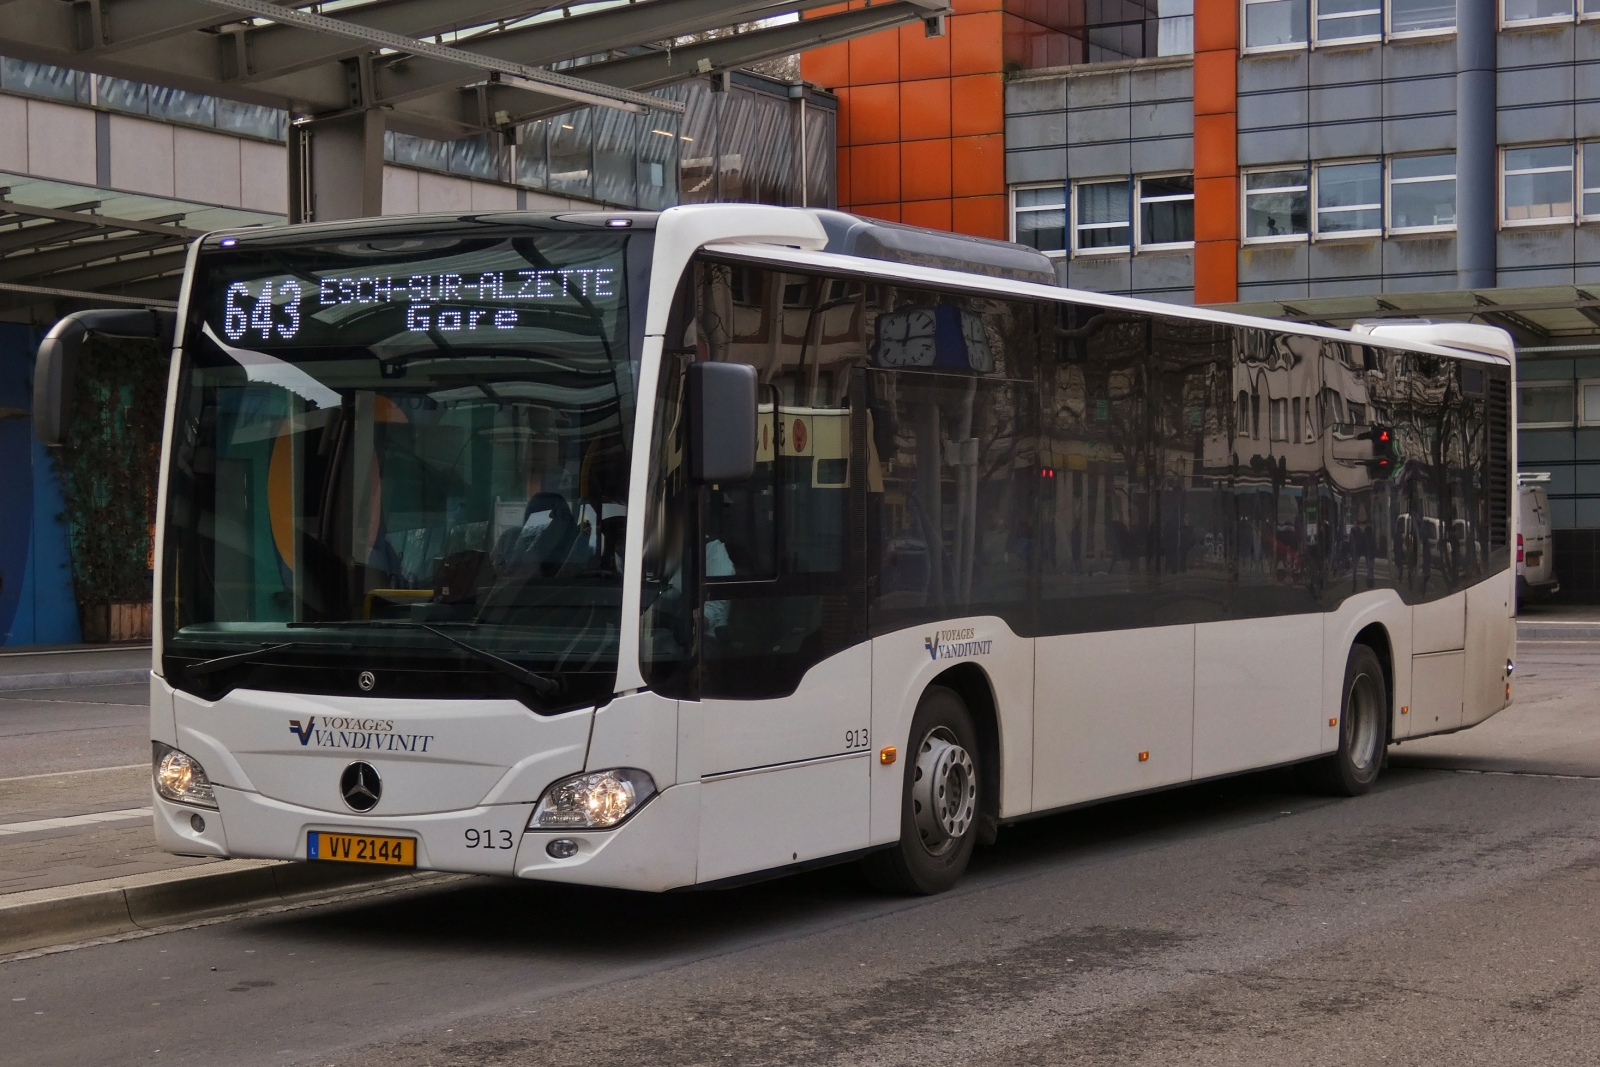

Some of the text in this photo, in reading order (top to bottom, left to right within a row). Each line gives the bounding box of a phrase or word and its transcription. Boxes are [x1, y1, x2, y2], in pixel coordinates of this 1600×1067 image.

[319, 268, 614, 306] ESCH-SUR-ALZETTE
[224, 280, 301, 340] 643
[406, 306, 520, 332] Gare
[941, 628, 975, 642] VOYAGES
[938, 640, 993, 659] VANDIVINIT
[321, 716, 394, 732] VOYAGES
[314, 729, 434, 752] VANDIVINIT
[845, 728, 869, 749] 913
[329, 837, 352, 858] VV
[356, 839, 402, 862] 2144
[464, 828, 514, 850] 913
